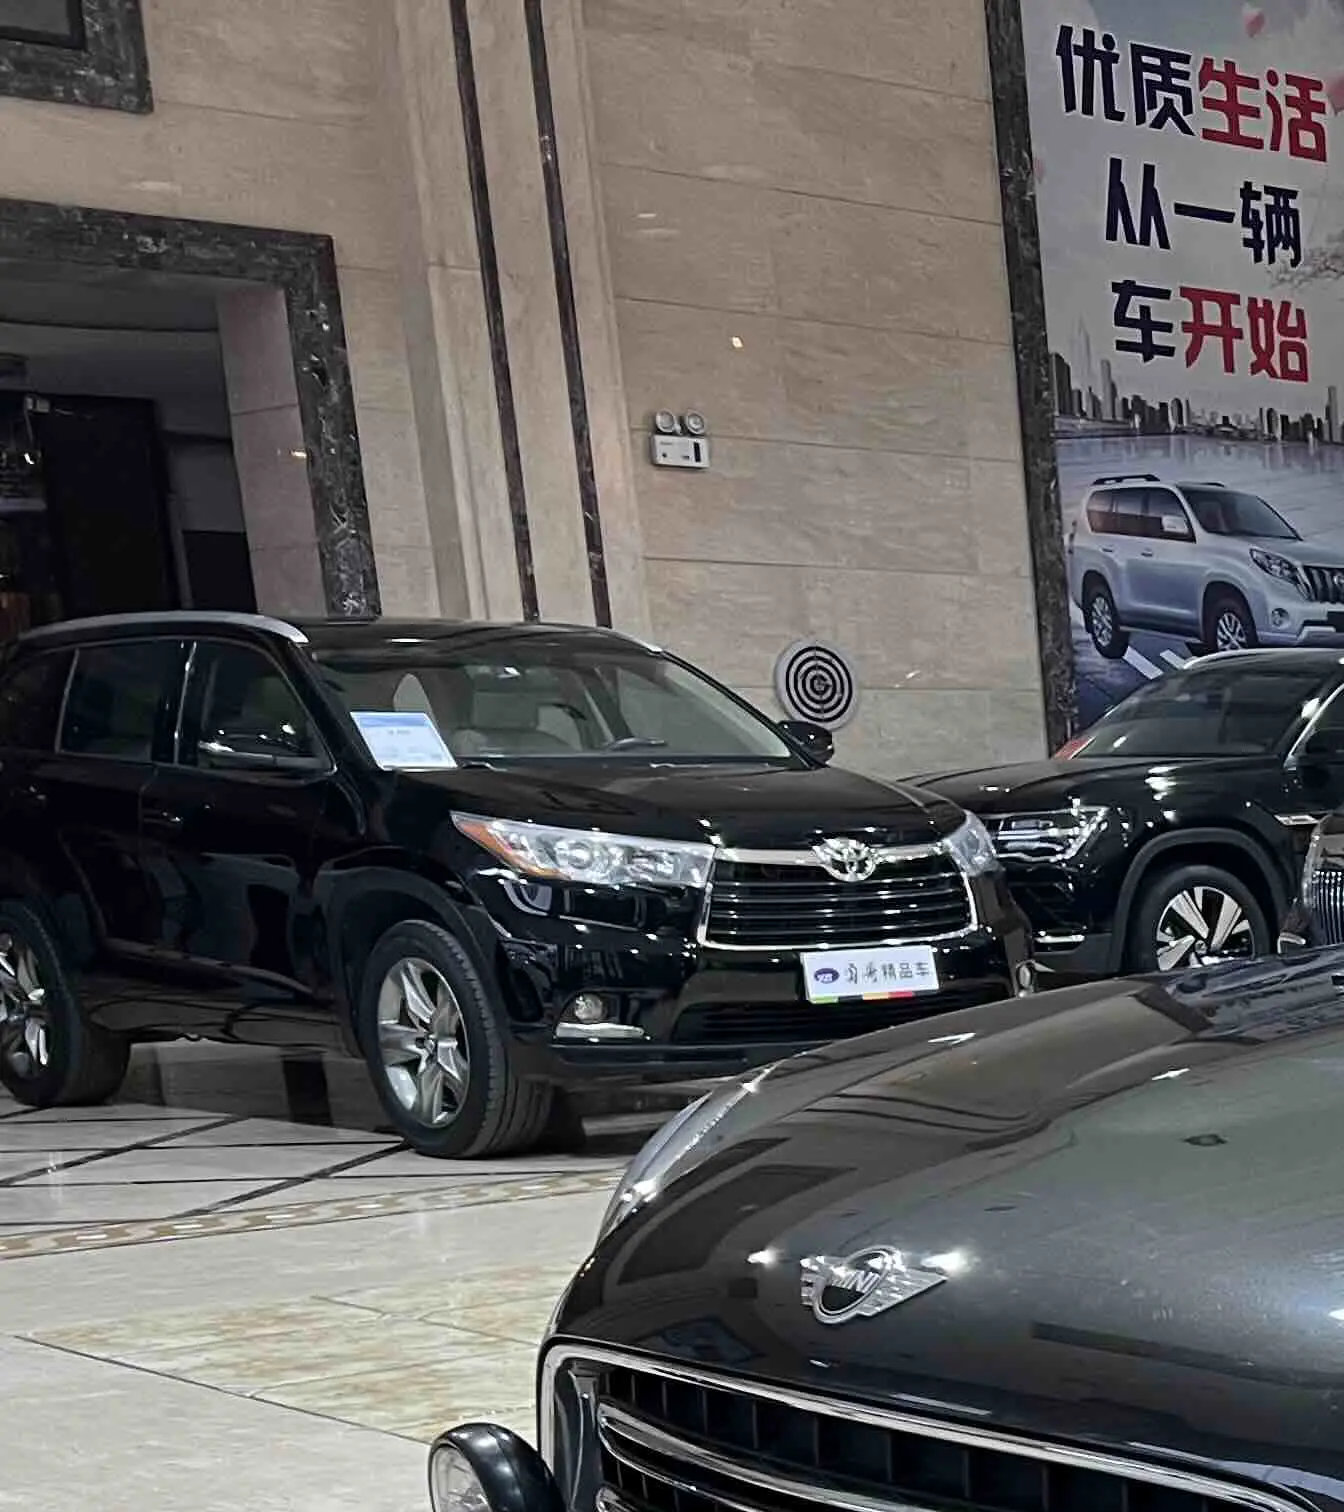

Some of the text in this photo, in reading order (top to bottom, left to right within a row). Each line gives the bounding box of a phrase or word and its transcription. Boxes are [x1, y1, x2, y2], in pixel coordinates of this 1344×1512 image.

[1056, 24, 1327, 163] 优质生活
[1105, 157, 1301, 267] 从一辆
[1112, 279, 1309, 383] 车开始
